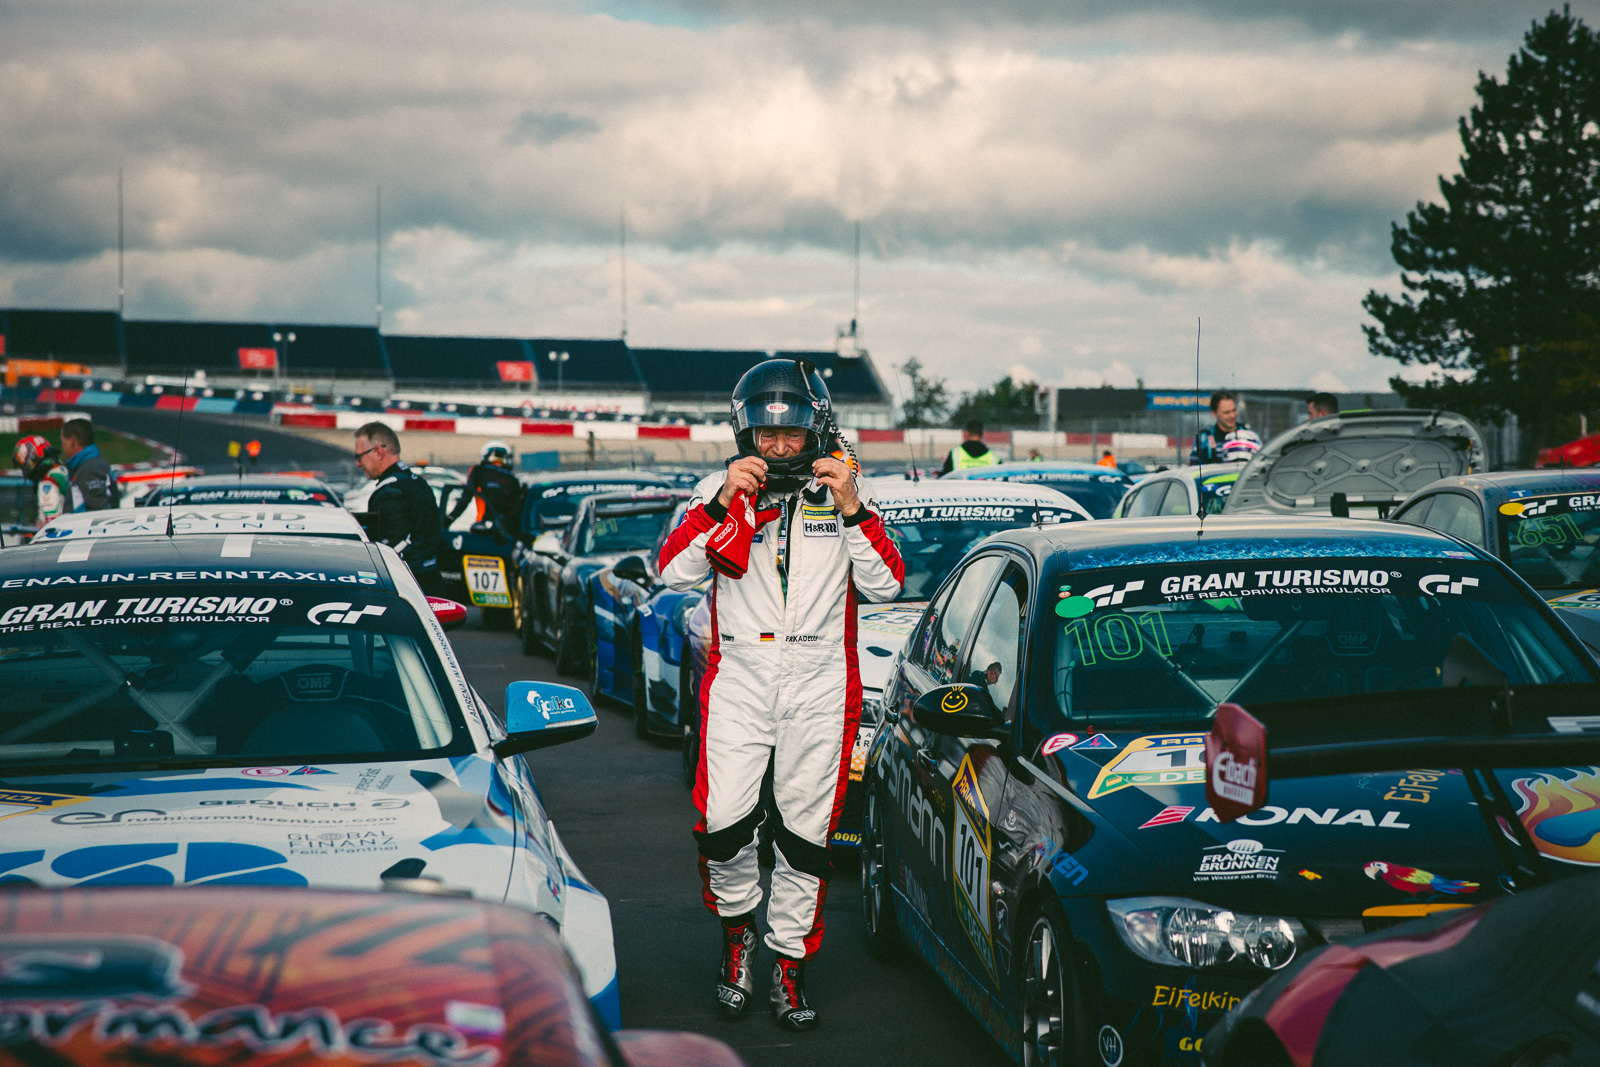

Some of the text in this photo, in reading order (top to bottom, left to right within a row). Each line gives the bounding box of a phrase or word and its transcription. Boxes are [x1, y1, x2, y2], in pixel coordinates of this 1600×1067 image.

[805, 523, 825, 533] H&R
[1517, 513, 1583, 547] 651
[473, 572, 499, 590] 107
[1160, 572, 1246, 594] GRAN
[1199, 590, 1240, 599] REAL
[1246, 587, 1301, 596] DRIVING
[1305, 587, 1392, 595] SIMULATOR
[0, 600, 108, 625] GRAN
[0, 615, 270, 633] THE REAL DRIVING SIMULATOR
[1064, 611, 1173, 666] 101
[298, 676, 332, 690] OMP
[1212, 752, 1258, 806] Eibach
[1199, 860, 1278, 872] BRUNNEN
[1202, 853, 1280, 863] FRANKEN
[959, 824, 983, 917] 101
